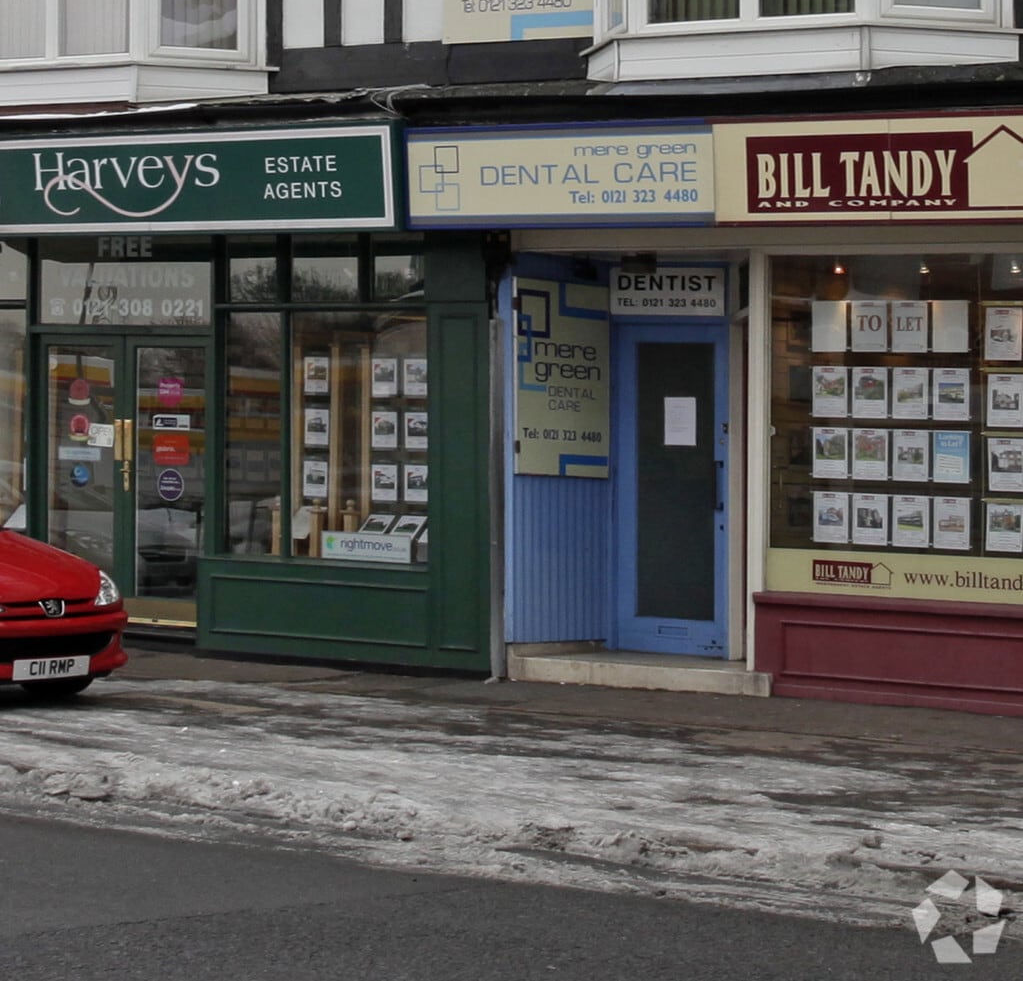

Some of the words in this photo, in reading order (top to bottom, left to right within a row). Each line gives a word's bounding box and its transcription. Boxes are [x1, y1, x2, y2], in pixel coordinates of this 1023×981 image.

[573, 144, 629, 157] mere
[636, 143, 697, 159] green
[264, 155, 338, 174] ESTATE
[480, 164, 599, 186] DENTAL
[613, 161, 698, 183] CARE
[756, 152, 831, 199] BILL
[839, 149, 957, 198] TANDY
[32, 151, 221, 218] Harveys
[263, 181, 343, 200] AGENTS
[568, 190, 595, 205] Tel:
[601, 190, 626, 204] 0121
[632, 190, 656, 204] 323
[663, 188, 699, 204] 4480
[757, 200, 809, 208] AND
[828, 199, 957, 207] COMPANY
[97, 236, 153, 257] FREE
[61, 266, 195, 287] VAUATIONS
[617, 275, 717, 292] DENTIST
[161, 299, 204, 317] 0221
[617, 298, 640, 308] TEL:
[642, 298, 664, 308] 0121
[668, 298, 687, 308] 323
[690, 298, 717, 308] 4480
[856, 314, 883, 332] TO
[895, 316, 923, 332] LET
[534, 341, 597, 361] mere
[534, 361, 601, 382] green
[548, 386, 596, 401] DENTAL
[548, 399, 581, 412] CARE
[522, 427, 540, 439] Tel:
[563, 430, 577, 441] 323
[581, 431, 602, 442] 4480
[815, 563, 836, 578] BILL
[837, 565, 869, 580] TANDY
[49, 658, 75, 675] RMP
